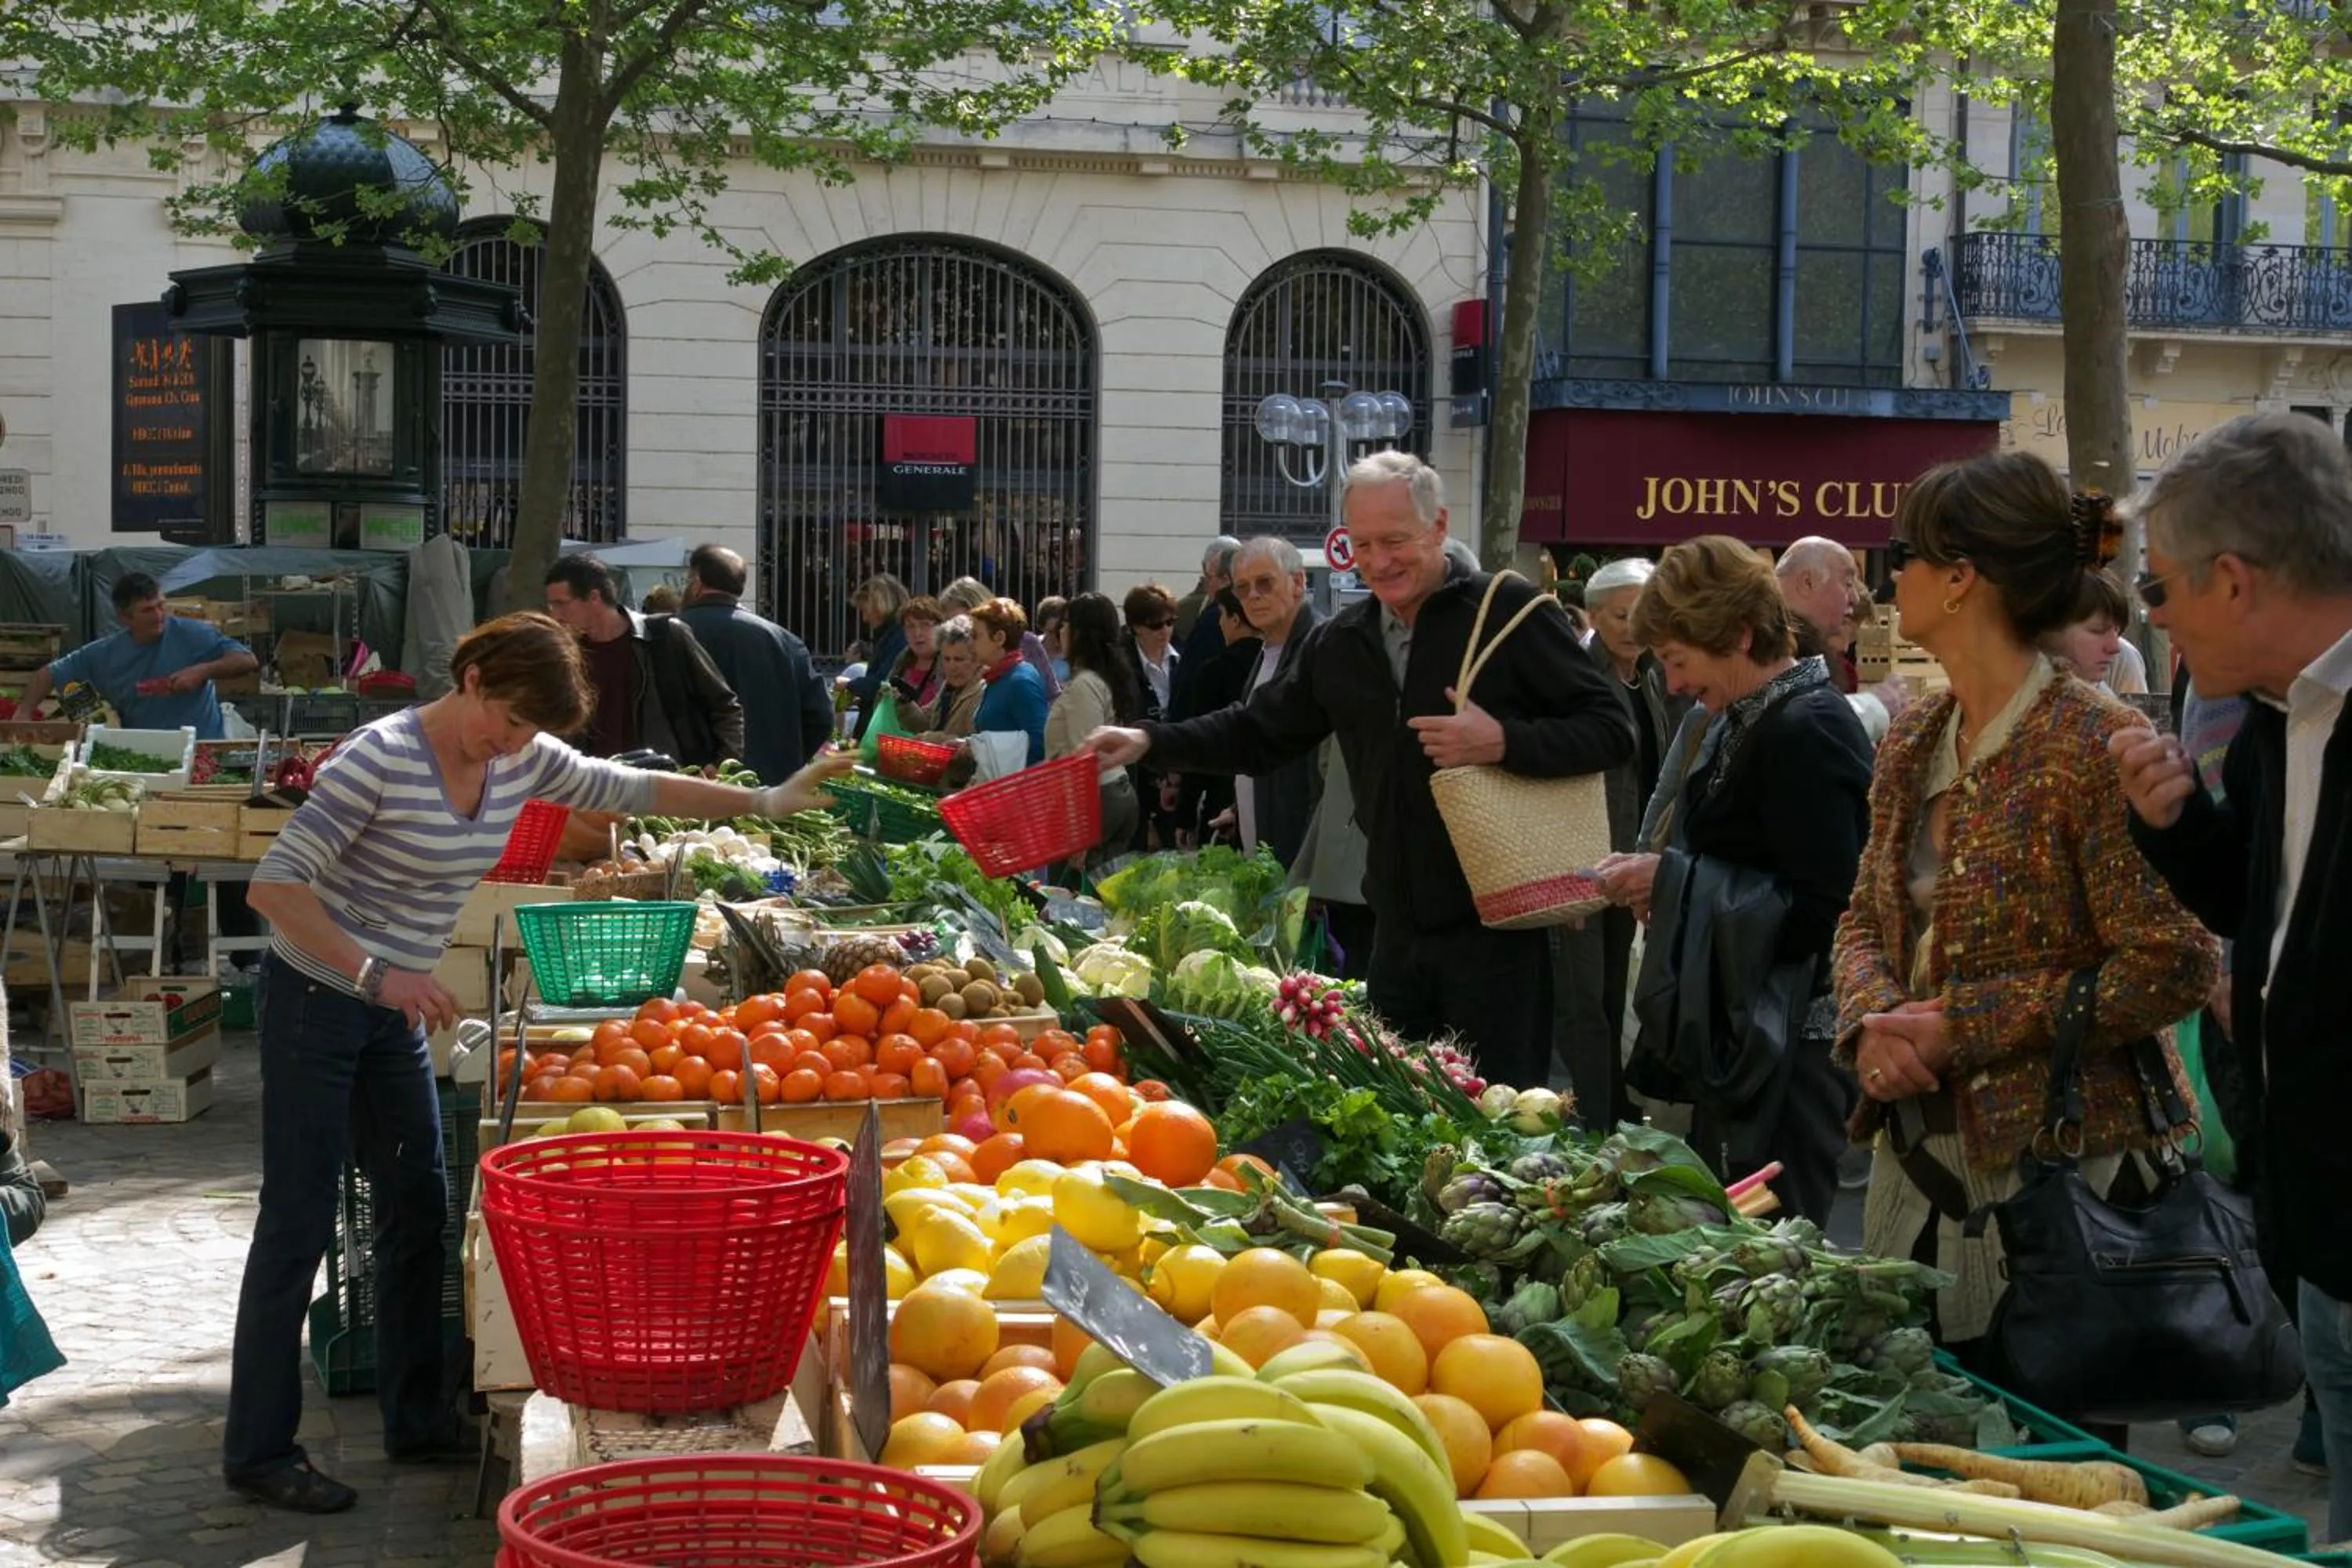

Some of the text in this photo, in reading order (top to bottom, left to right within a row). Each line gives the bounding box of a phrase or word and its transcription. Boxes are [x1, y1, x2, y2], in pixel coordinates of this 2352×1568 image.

[892, 464, 967, 475] GENERALE
[1636, 477, 1911, 520] JOHN'S CLU
